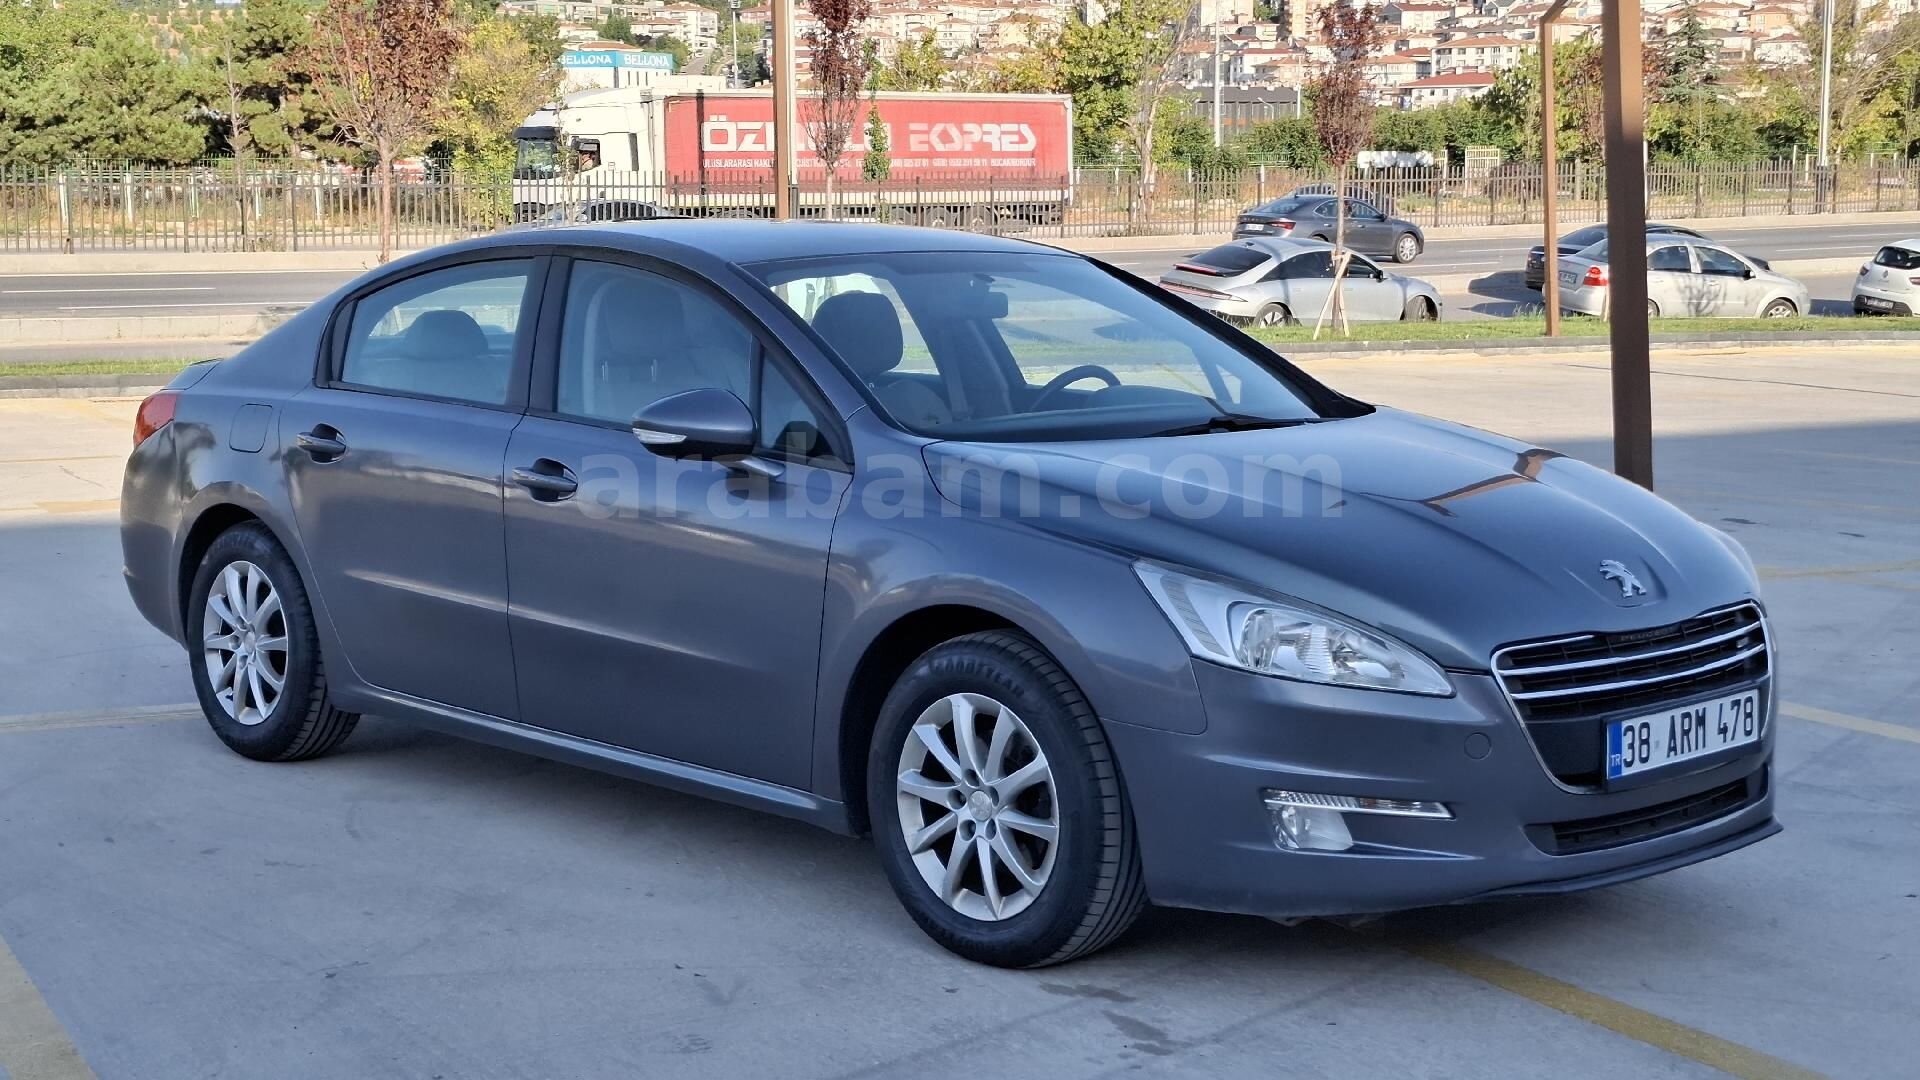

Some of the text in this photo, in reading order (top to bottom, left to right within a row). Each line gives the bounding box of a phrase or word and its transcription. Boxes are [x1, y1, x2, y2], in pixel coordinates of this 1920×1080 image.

[624, 53, 670, 66] BELLONA
[1623, 695, 1754, 768] 38 ARM 478
[1610, 753, 1621, 767] TR
